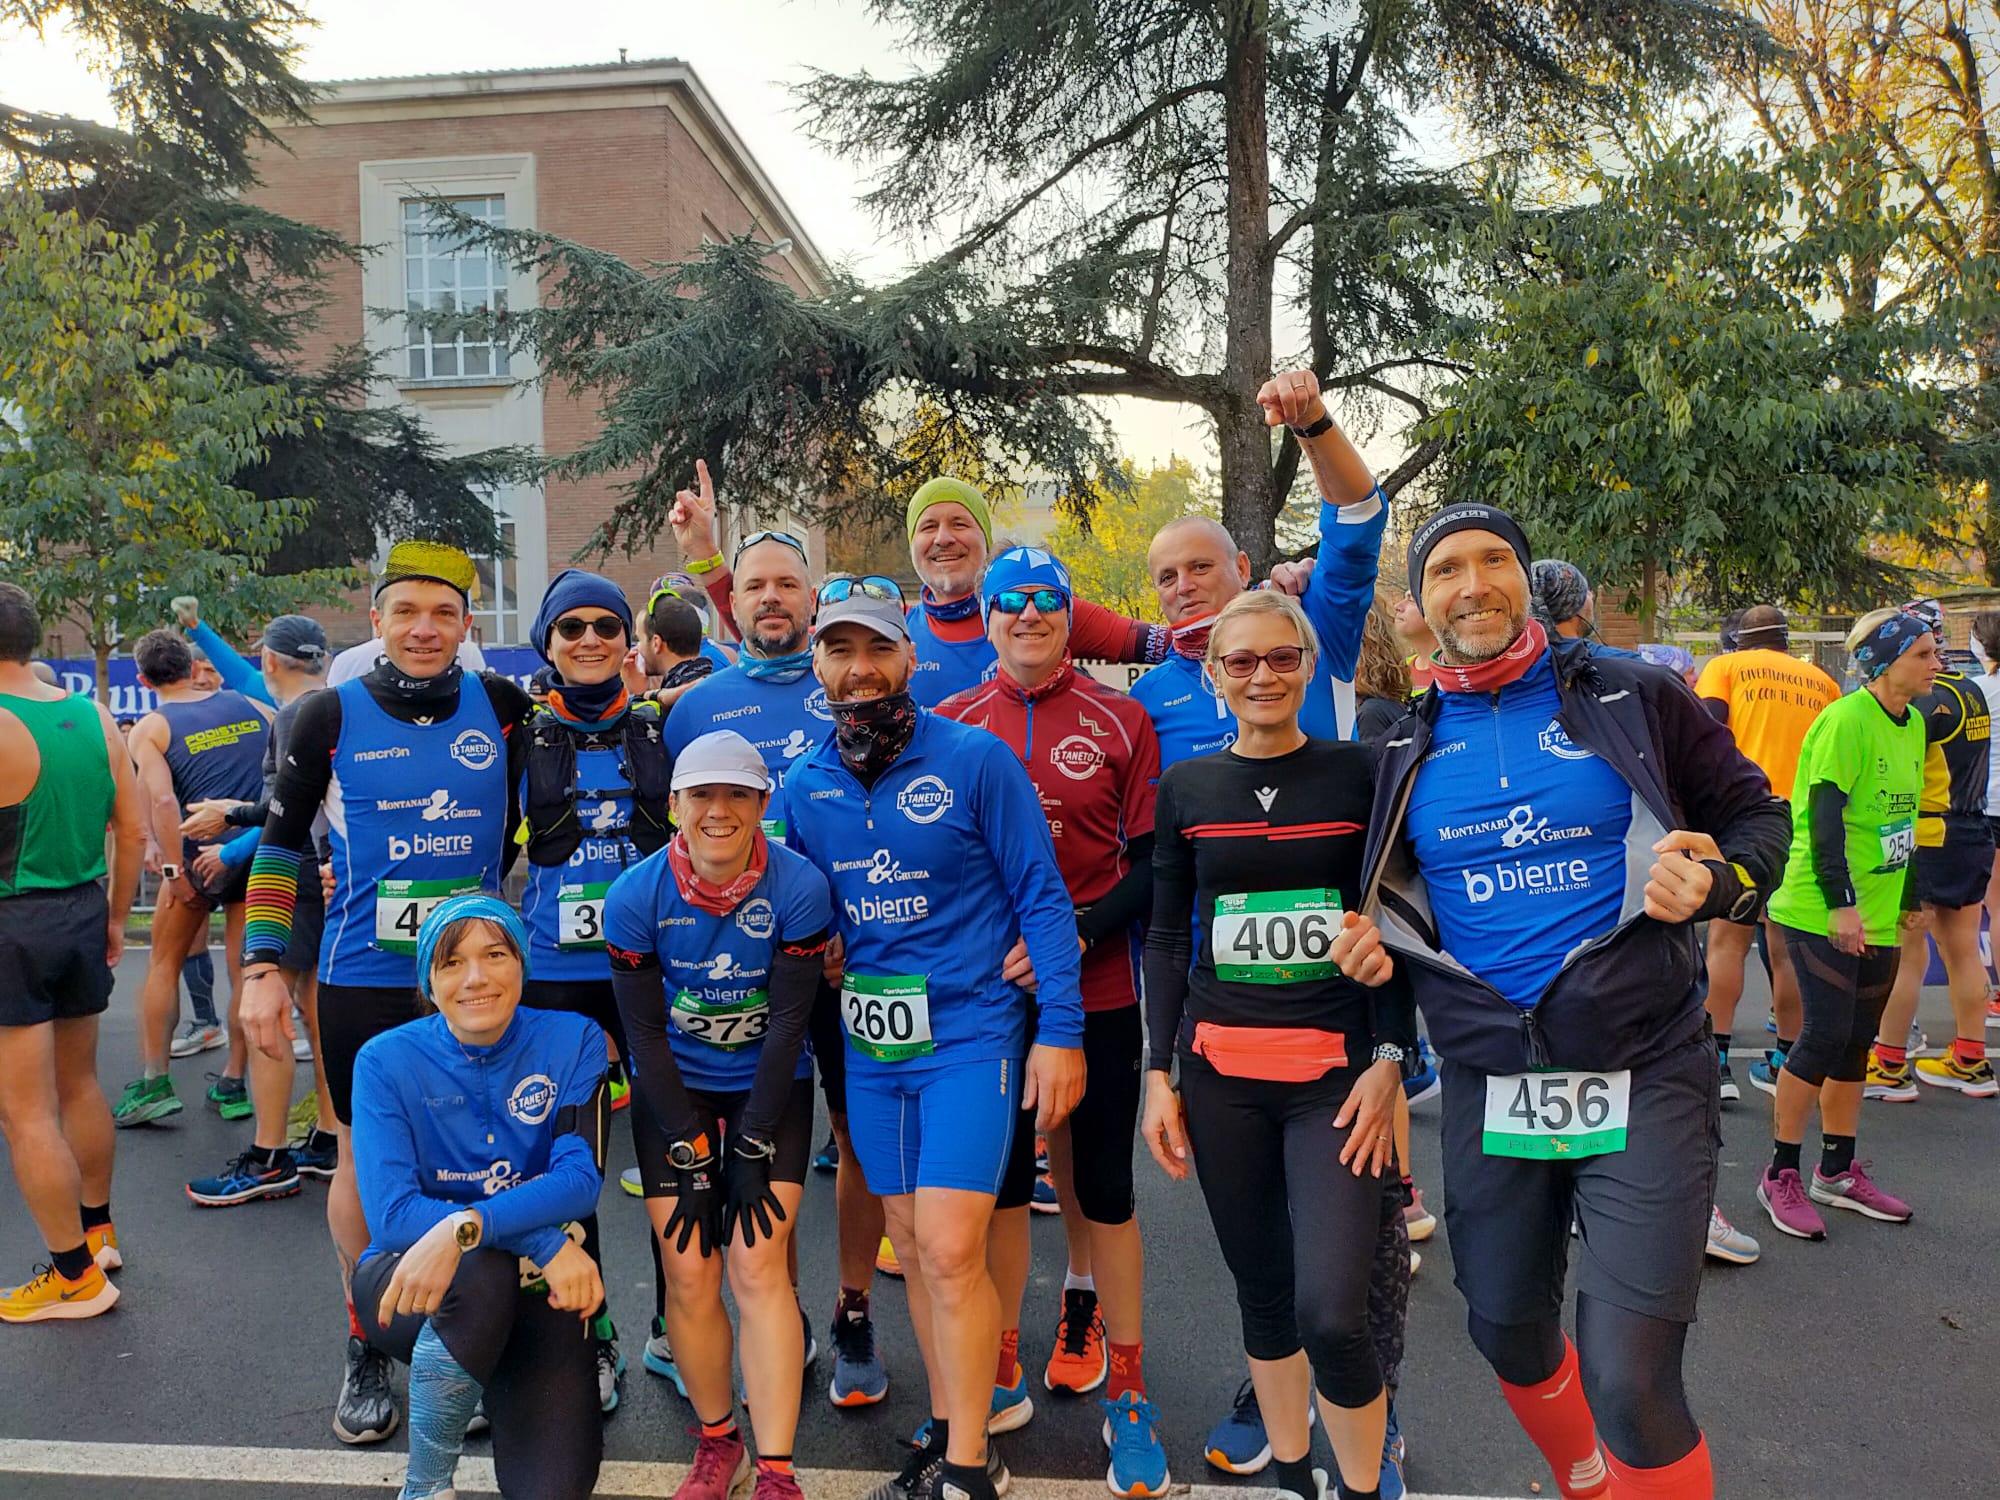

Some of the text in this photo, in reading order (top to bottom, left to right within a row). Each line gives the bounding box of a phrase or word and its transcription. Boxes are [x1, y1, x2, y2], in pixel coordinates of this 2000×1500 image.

[1144, 624, 1159, 663] PARMA
[1758, 687, 1777, 701] CON
[712, 705, 761, 722] macron
[184, 720, 261, 746] PODISTICA
[354, 747, 410, 763] macron
[461, 744, 489, 754] TANETO
[1062, 751, 1094, 762] TANETO
[810, 788, 844, 800] macron
[908, 793, 942, 804] TANETO
[376, 798, 431, 811] MONTANARI
[450, 808, 482, 819] GRUZZA
[1438, 818, 1509, 842] MONTANARI
[1540, 826, 1593, 842] GRUZZA
[414, 833, 473, 854] bierre
[1887, 831, 1912, 864] 254
[832, 859, 875, 872] MONTANARI
[894, 870, 930, 882] GRUZZA
[1495, 859, 1589, 892] bierre
[1528, 882, 1592, 896] AUTOMAZIONI
[861, 895, 929, 922] bierre
[883, 913, 929, 924] AUTOMAZIONI
[658, 917, 696, 928] macron
[1233, 915, 1331, 961] 406
[670, 959, 716, 970] MONTANARI
[734, 968, 766, 978] GRUZZA
[703, 987, 758, 1001] bierre
[686, 1012, 769, 1042] 273
[849, 997, 914, 1041] 260
[1508, 1077, 1610, 1131] 456
[437, 1168, 490, 1182] MONTANARI
